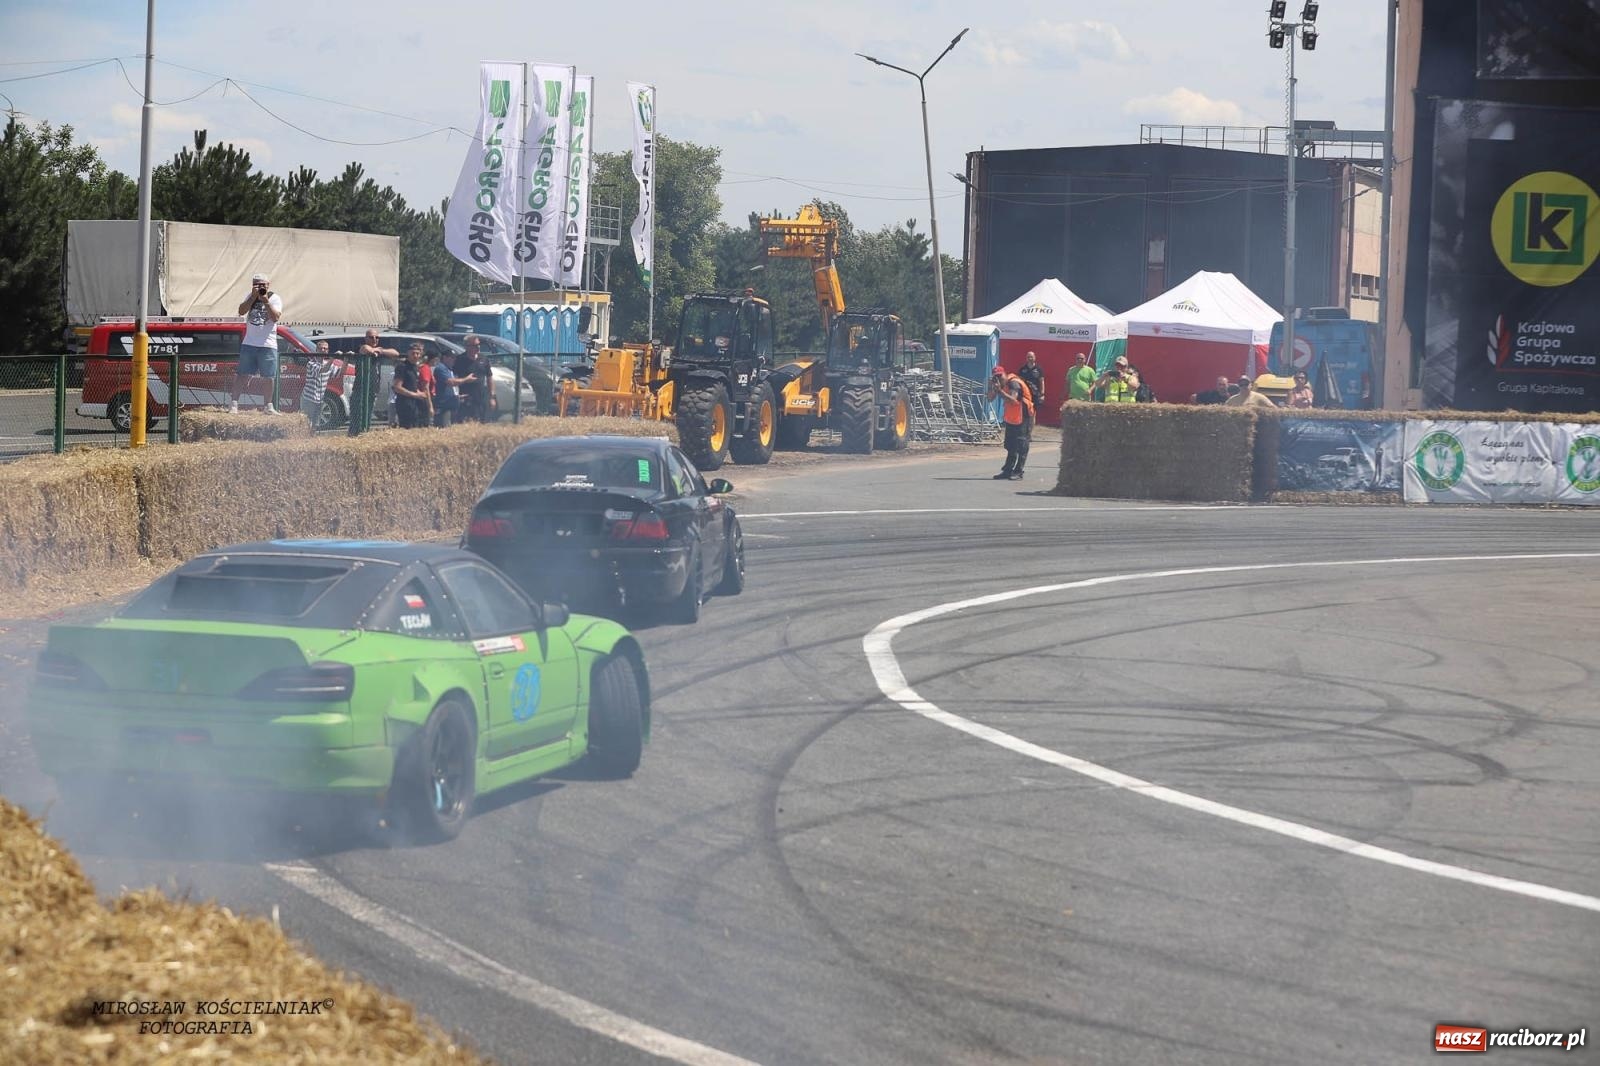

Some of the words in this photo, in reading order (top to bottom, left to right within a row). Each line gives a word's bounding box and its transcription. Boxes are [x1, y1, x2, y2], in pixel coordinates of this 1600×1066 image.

[1021, 306, 1054, 315] MITKO
[1172, 303, 1201, 314] MITKO
[1517, 322, 1575, 337] Krajowa
[1516, 336, 1561, 349] Grupa
[1514, 351, 1597, 366] Spożywcza
[1497, 381, 1528, 394] Grupa
